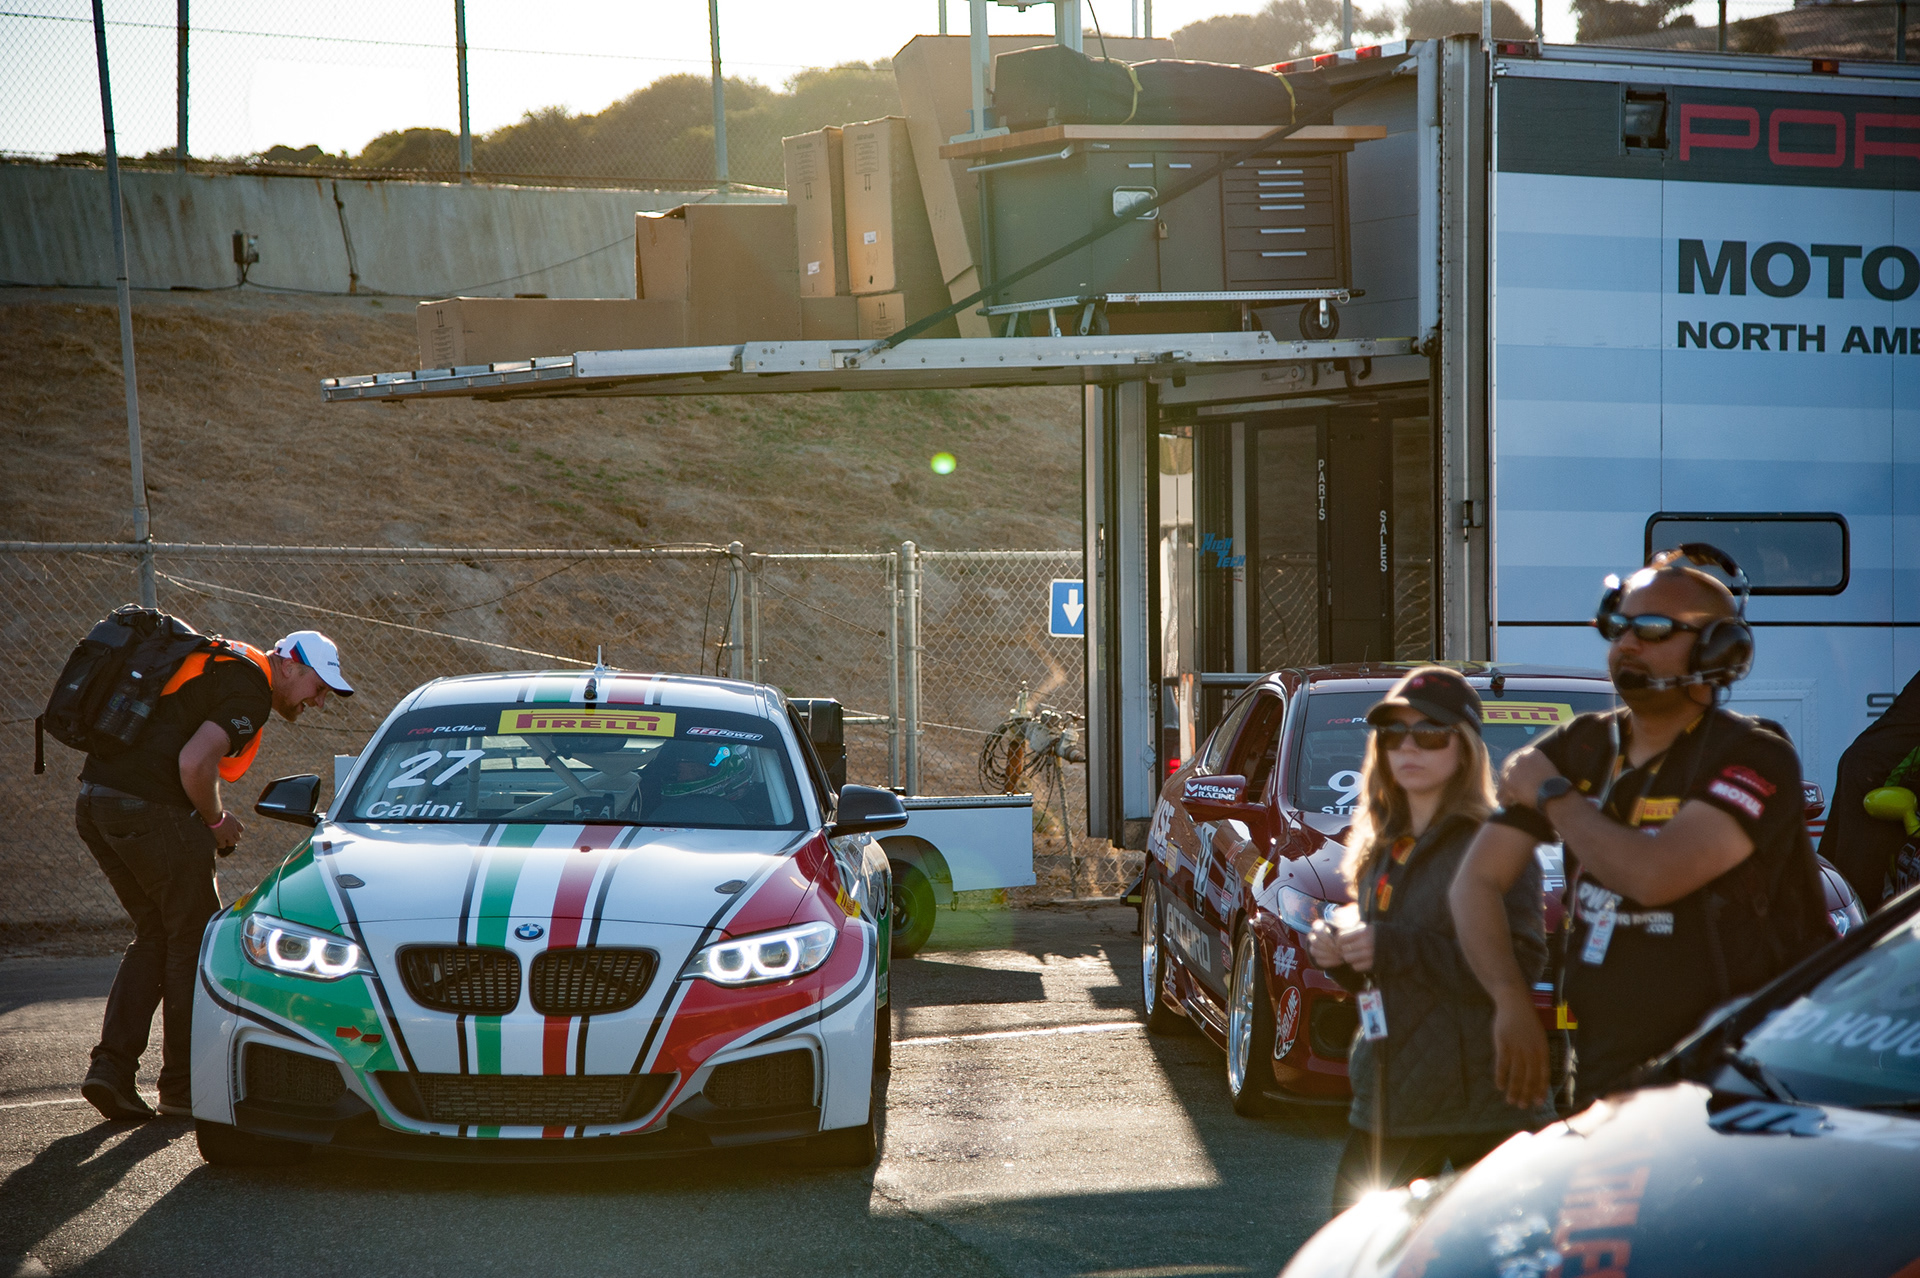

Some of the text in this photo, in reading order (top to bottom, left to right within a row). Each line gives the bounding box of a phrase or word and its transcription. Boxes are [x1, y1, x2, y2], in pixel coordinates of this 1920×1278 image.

[1679, 103, 1920, 169] POR
[1677, 238, 1920, 302] MOTO
[1677, 320, 1826, 353] NORTH
[1318, 458, 1326, 521] PARTS
[1379, 510, 1388, 572] SALES
[515, 712, 661, 731] PIRELLI
[1482, 704, 1559, 721] ELLI
[387, 749, 486, 789] 27
[1198, 784, 1236, 795] MEGAN
[1198, 790, 1236, 801] RACING
[1711, 782, 1762, 816] MOTUL
[365, 800, 463, 819] Carini
[1166, 902, 1212, 973] ACCORD
